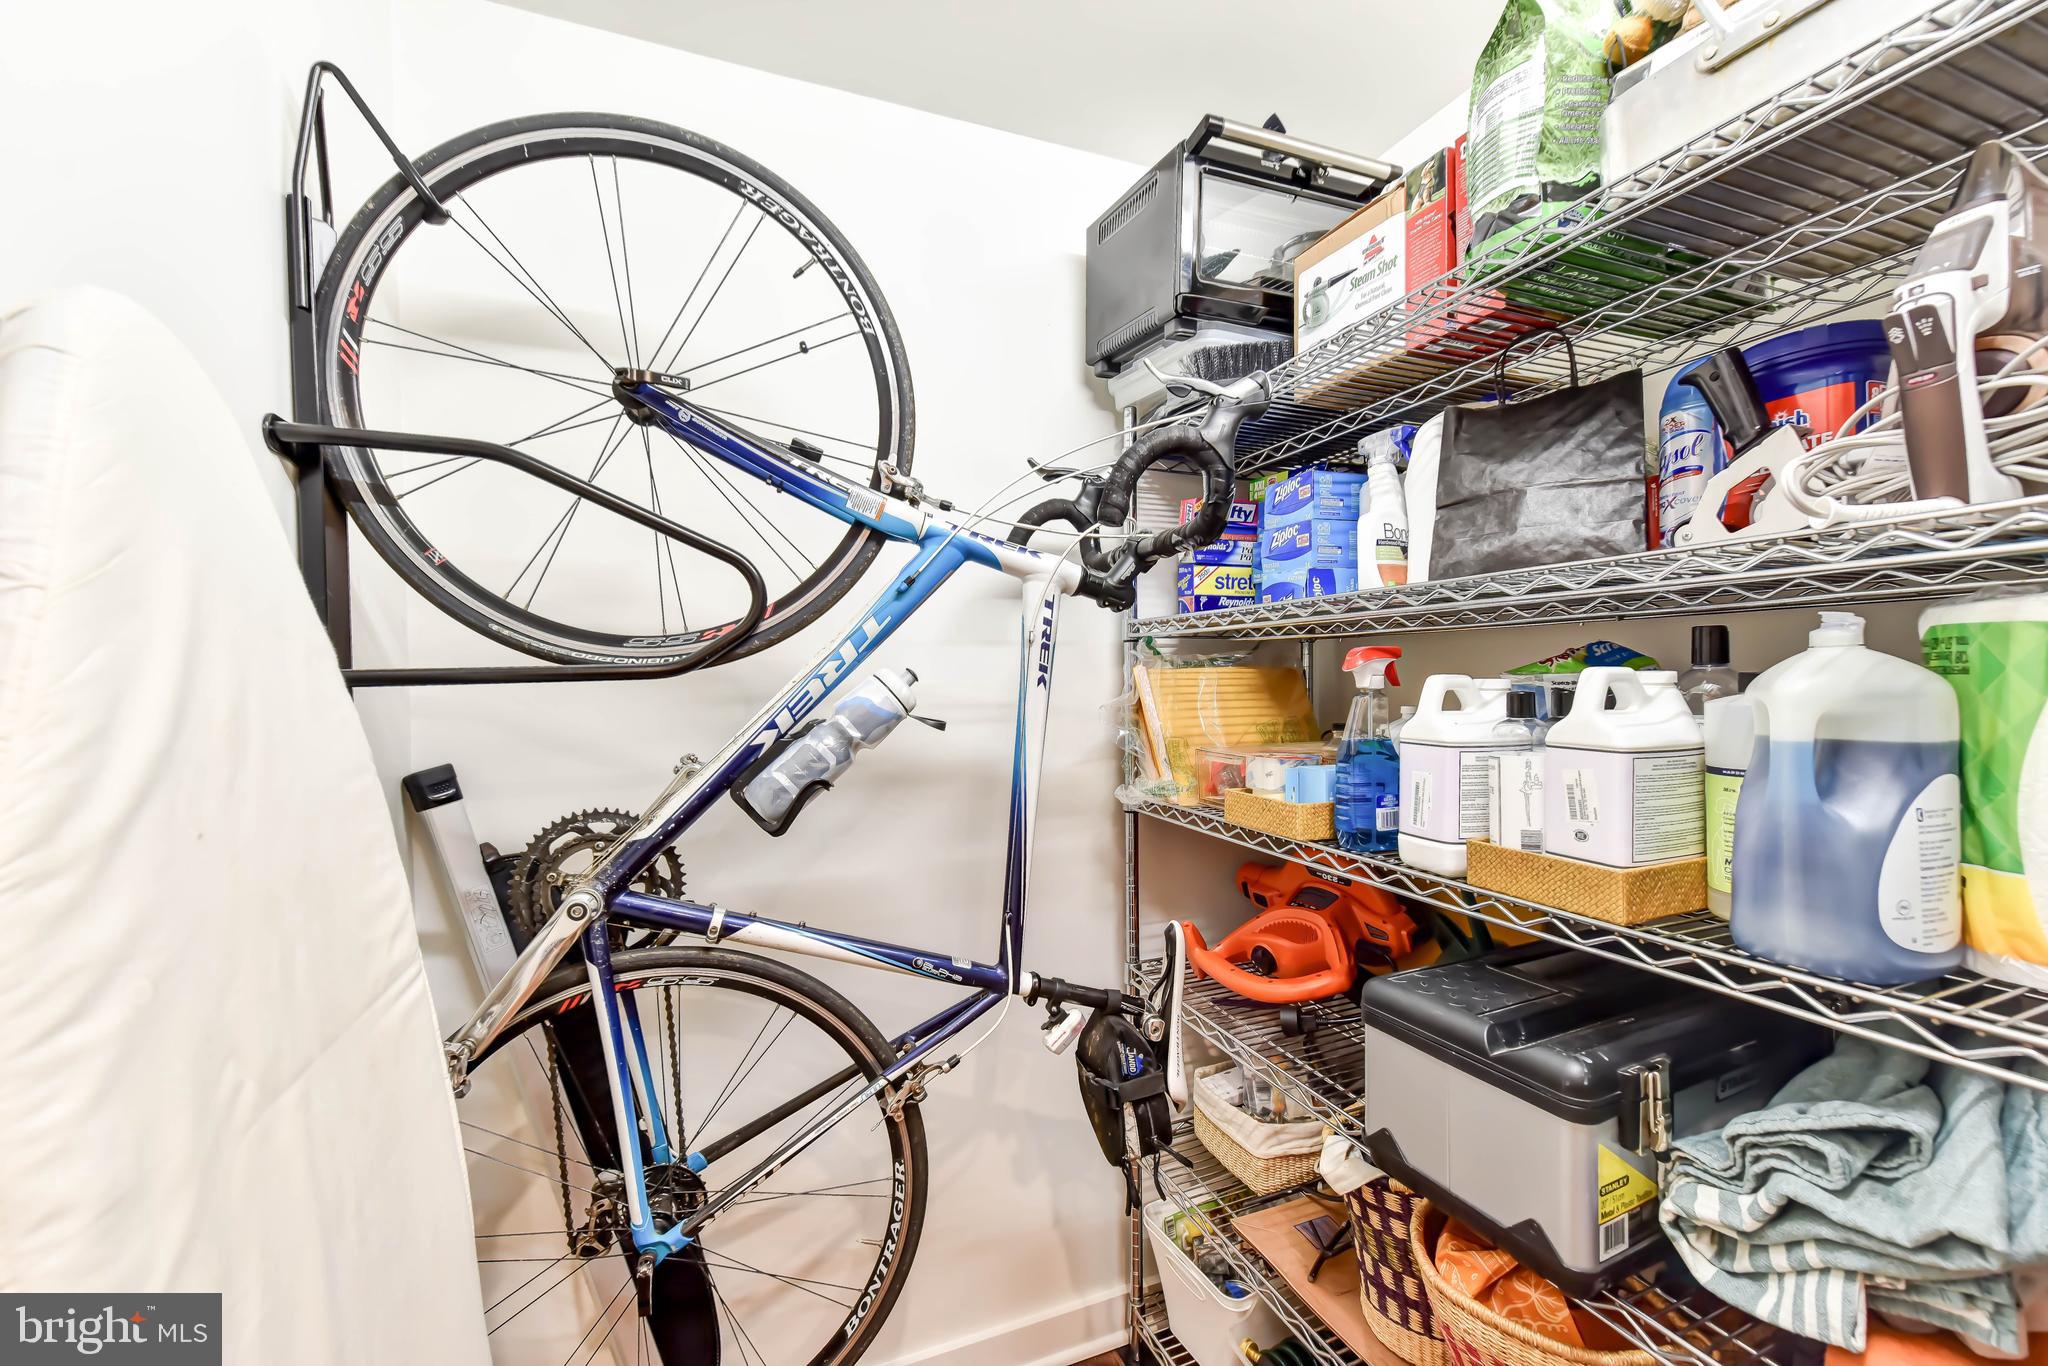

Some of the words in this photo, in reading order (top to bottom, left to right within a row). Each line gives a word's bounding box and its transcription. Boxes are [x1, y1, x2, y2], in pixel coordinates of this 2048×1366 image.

[739, 181, 876, 336] BONTRAGER
[1349, 268, 1376, 292] Steam
[1377, 255, 1399, 277] Shot
[786, 453, 851, 493] TRE
[1273, 476, 1301, 506] Ziploc
[1230, 504, 1254, 524] fty
[945, 521, 1042, 560] TREK
[1270, 523, 1300, 551] Ziploc
[1214, 573, 1255, 591] stret
[1218, 596, 1255, 607] Reynolds
[1037, 593, 1059, 691] TREK
[752, 613, 892, 758] TREK
[1321, 872, 1339, 883] 230
[1601, 1177, 1629, 1195] STANLEY
[844, 1159, 906, 1340] BONTRAGER
